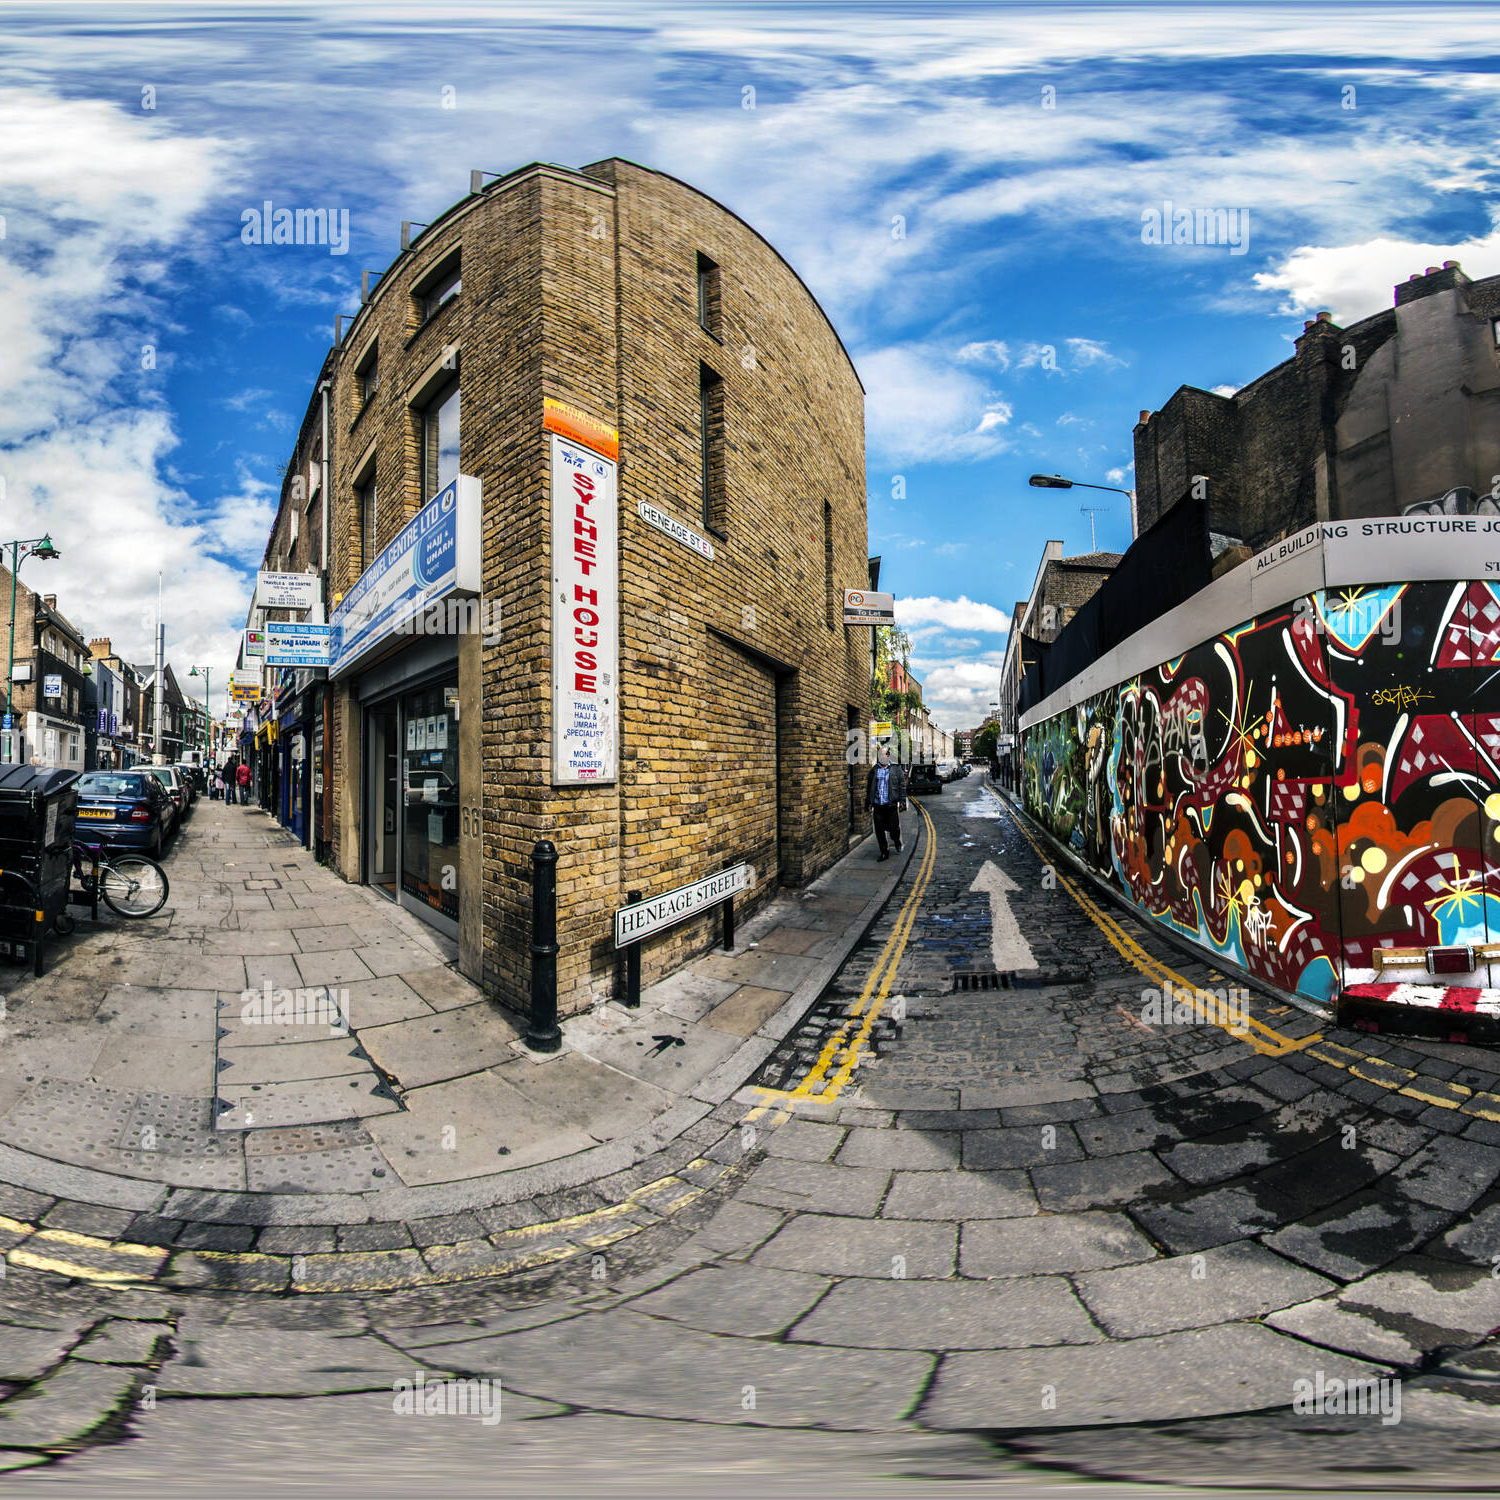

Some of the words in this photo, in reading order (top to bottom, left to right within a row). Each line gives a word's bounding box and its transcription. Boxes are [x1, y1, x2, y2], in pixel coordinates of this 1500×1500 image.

[564, 457, 582, 469] IATA
[572, 472, 598, 576] SYLHET
[643, 505, 688, 541] HENEAGE
[366, 559, 386, 588] TRAVEL
[388, 526, 418, 567] CENTRE
[420, 505, 439, 533] LTD
[1257, 552, 1277, 571] ALL
[1279, 525, 1348, 559] BUILDING
[1362, 520, 1477, 536] STRUCTURE
[573, 584, 599, 694] HOUSE
[573, 702, 598, 712] TRAVEL
[574, 711, 591, 720] HAJJ
[566, 728, 604, 737] SPECIALIST
[573, 720, 598, 729] UMRAH
[462, 806, 480, 839] 66
[621, 890, 693, 934] HENEAGE
[696, 872, 737, 903] STREET
